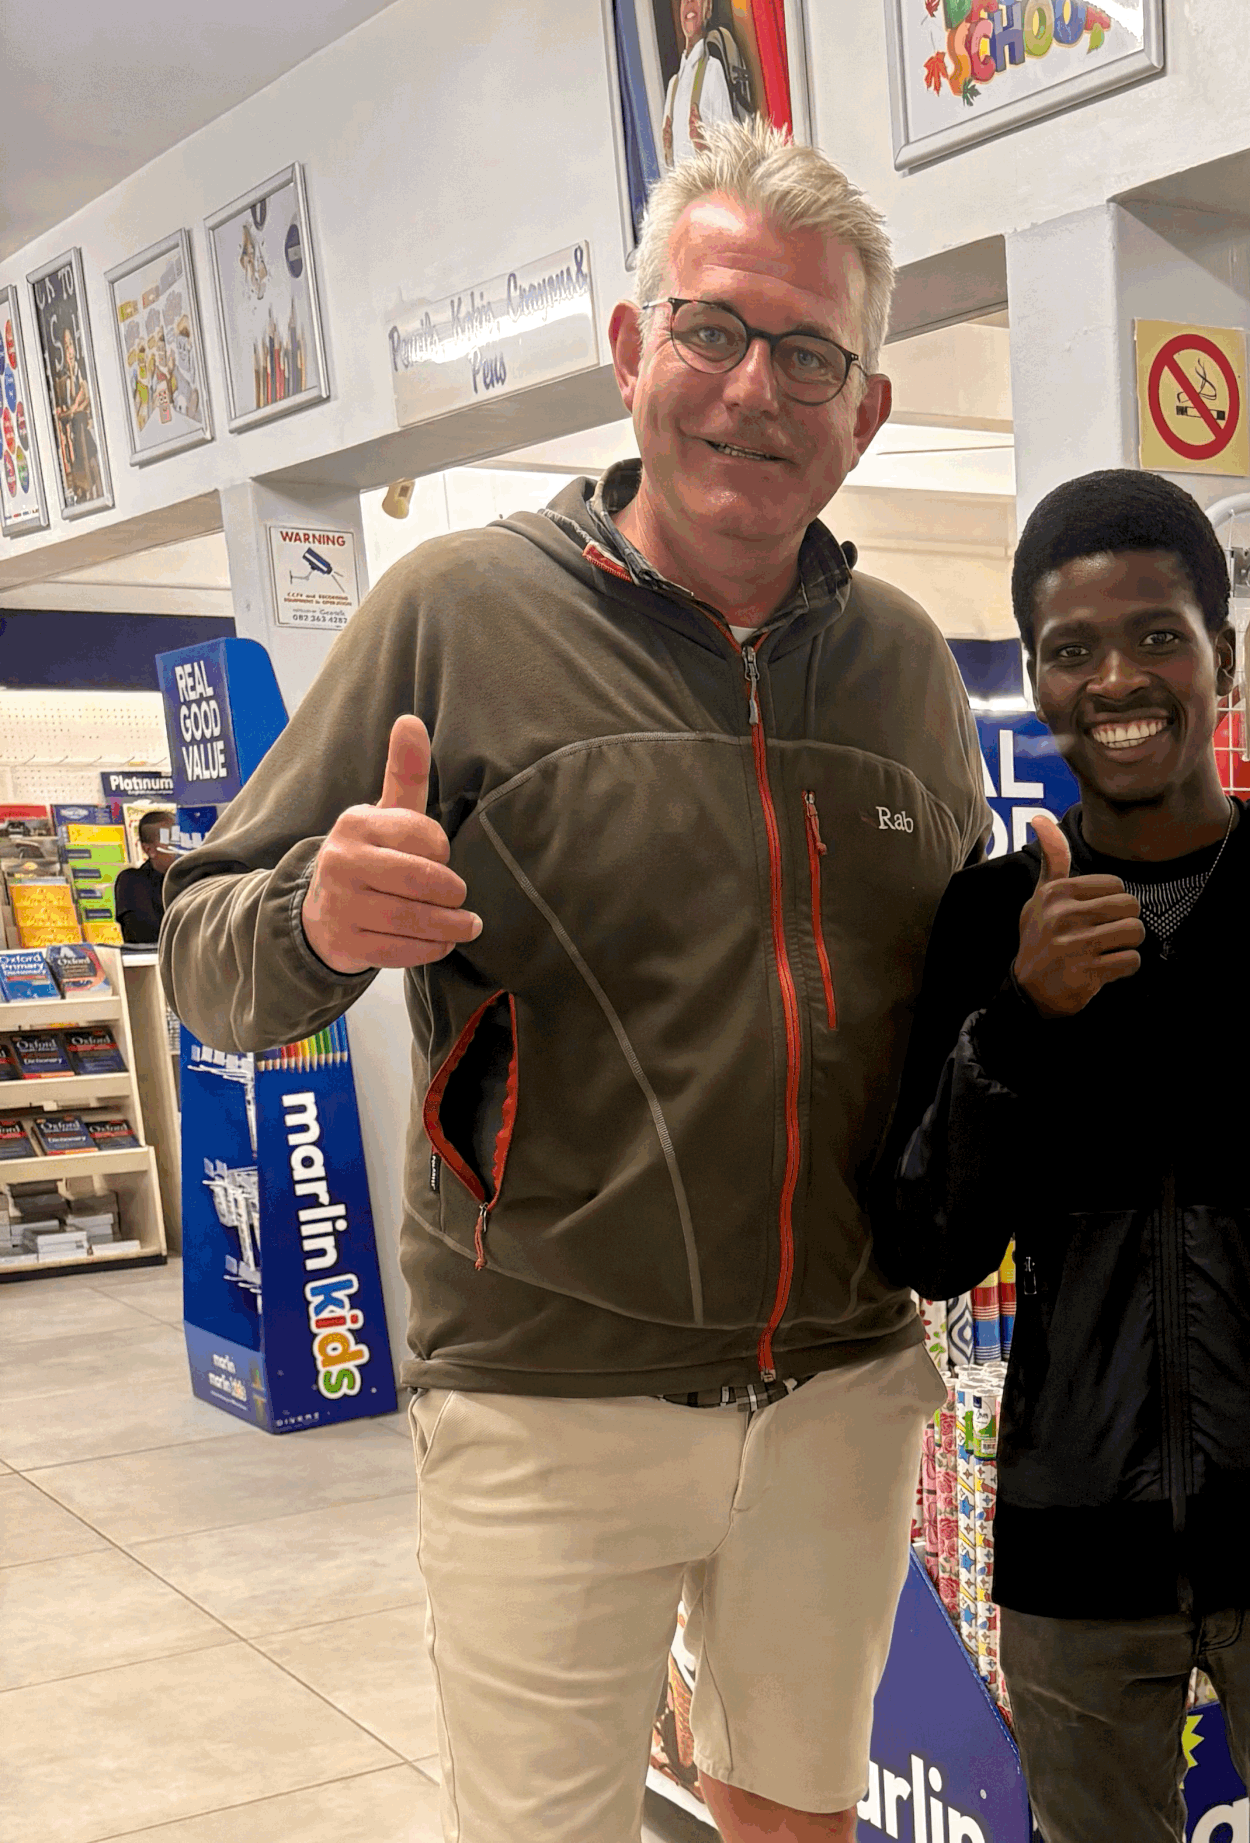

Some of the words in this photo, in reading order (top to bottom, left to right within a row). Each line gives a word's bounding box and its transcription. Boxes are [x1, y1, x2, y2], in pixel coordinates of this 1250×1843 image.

[280, 531, 346, 547] WARNING
[175, 660, 214, 703] REAL
[180, 700, 220, 742] GOOD
[182, 740, 228, 782] VALUE
[109, 775, 174, 791] Platinum
[875, 805, 914, 833] Rab
[0, 953, 42, 964] Oxford
[16, 1039, 57, 1050] Oxford
[71, 1035, 111, 1044] Oxford
[41, 1120, 81, 1131] Oxford
[282, 1091, 348, 1272] marlin
[305, 1273, 370, 1400] kids
